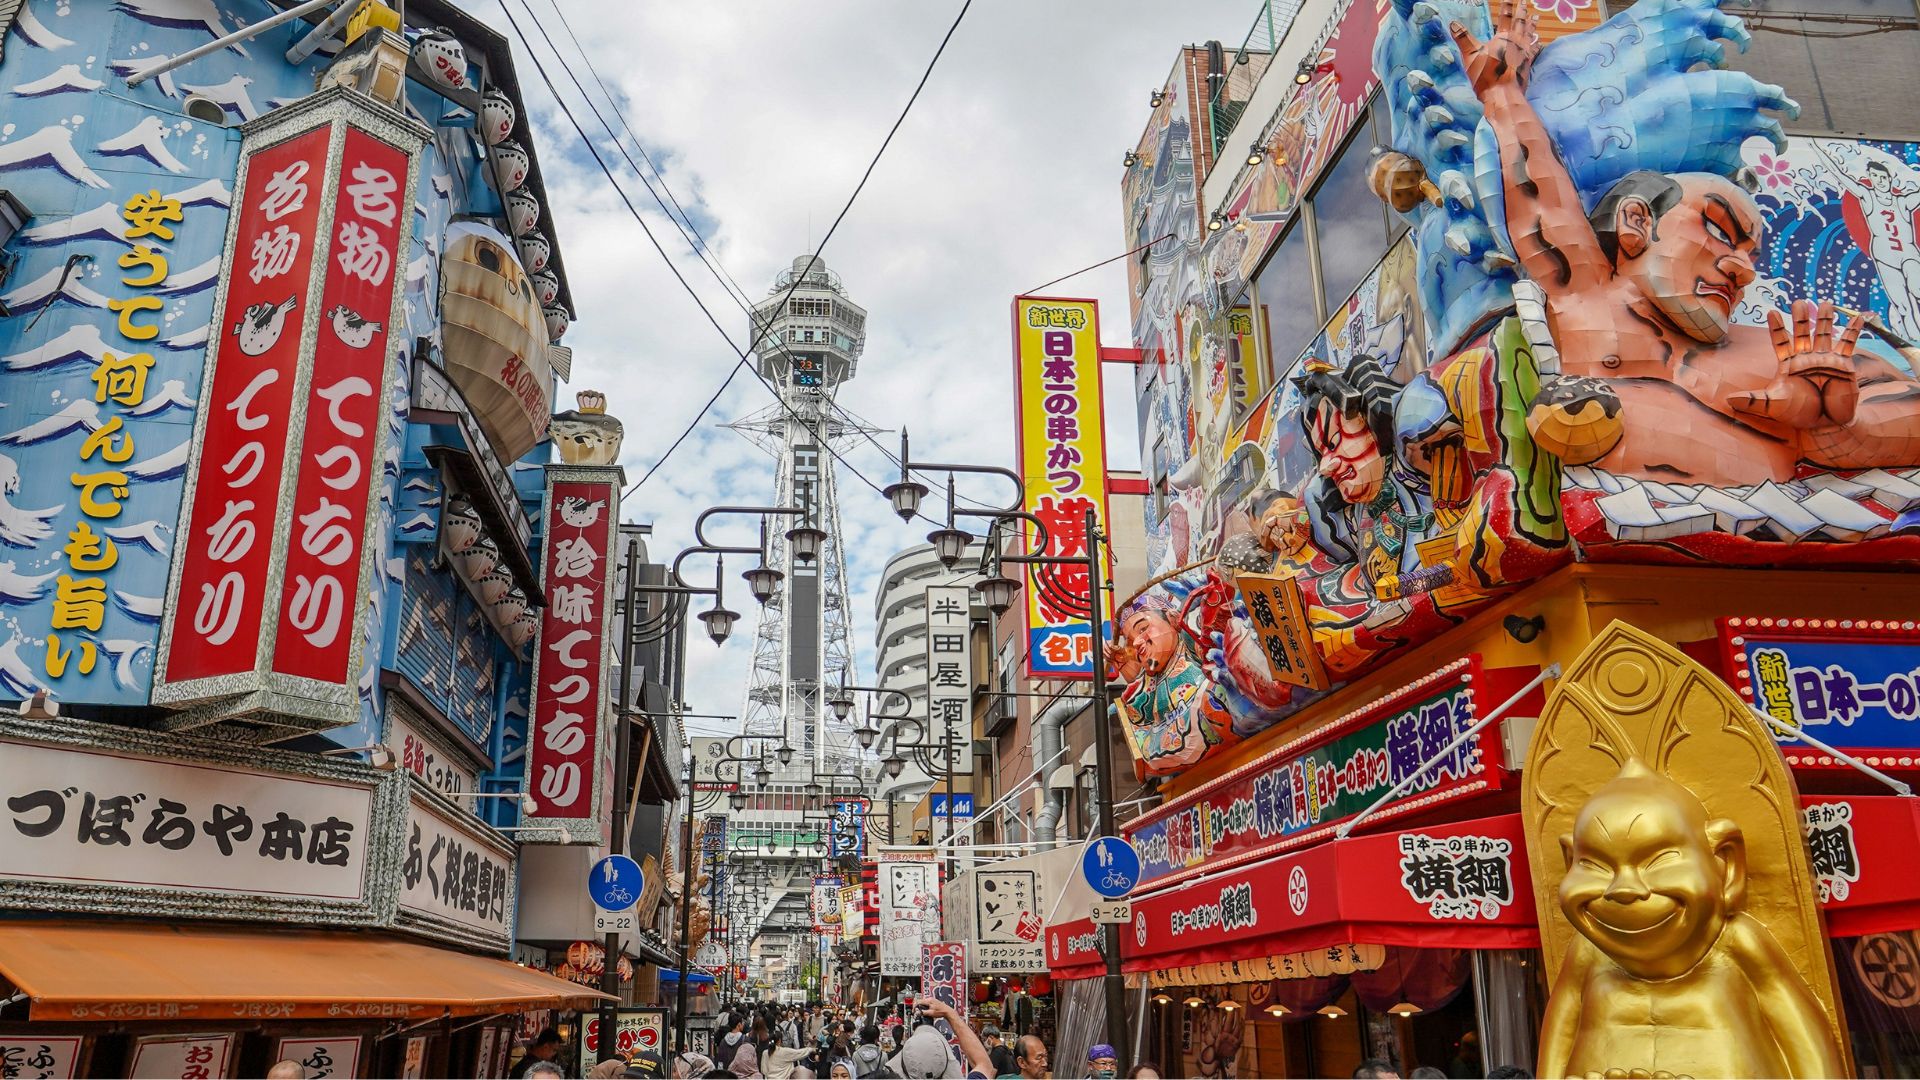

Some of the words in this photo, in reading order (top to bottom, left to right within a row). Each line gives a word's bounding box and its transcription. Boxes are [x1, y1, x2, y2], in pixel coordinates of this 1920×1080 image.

[1881, 208, 1904, 253] グリコ
[1029, 306, 1086, 329] 新世界
[45, 189, 184, 679] 安うて何んでも旨い
[1043, 331, 1081, 494] 日本一の串かつ
[194, 368, 279, 646] てっちり
[289, 376, 373, 648] てっちり
[540, 536, 598, 807] 珍味てっちり
[1757, 652, 1800, 738] 新世界
[1793, 669, 1920, 722] 日本一の
[1254, 767, 1294, 838] 横綱
[1317, 750, 1388, 808] 日本一の串かつ
[7, 786, 354, 867] づぼらや本店
[1402, 837, 1509, 853] 日本一の串かつ
[403, 820, 506, 924] ふぐ料理専門
[1404, 853, 1510, 902] 横綱
[1171, 905, 1219, 935] 日本一の串かつ
[1220, 881, 1252, 931] 横綱
[980, 948, 988, 957] 1F
[991, 948, 1043, 957] カウンター席
[980, 960, 988, 968] 2F
[991, 959, 1043, 968] 座敷あります
